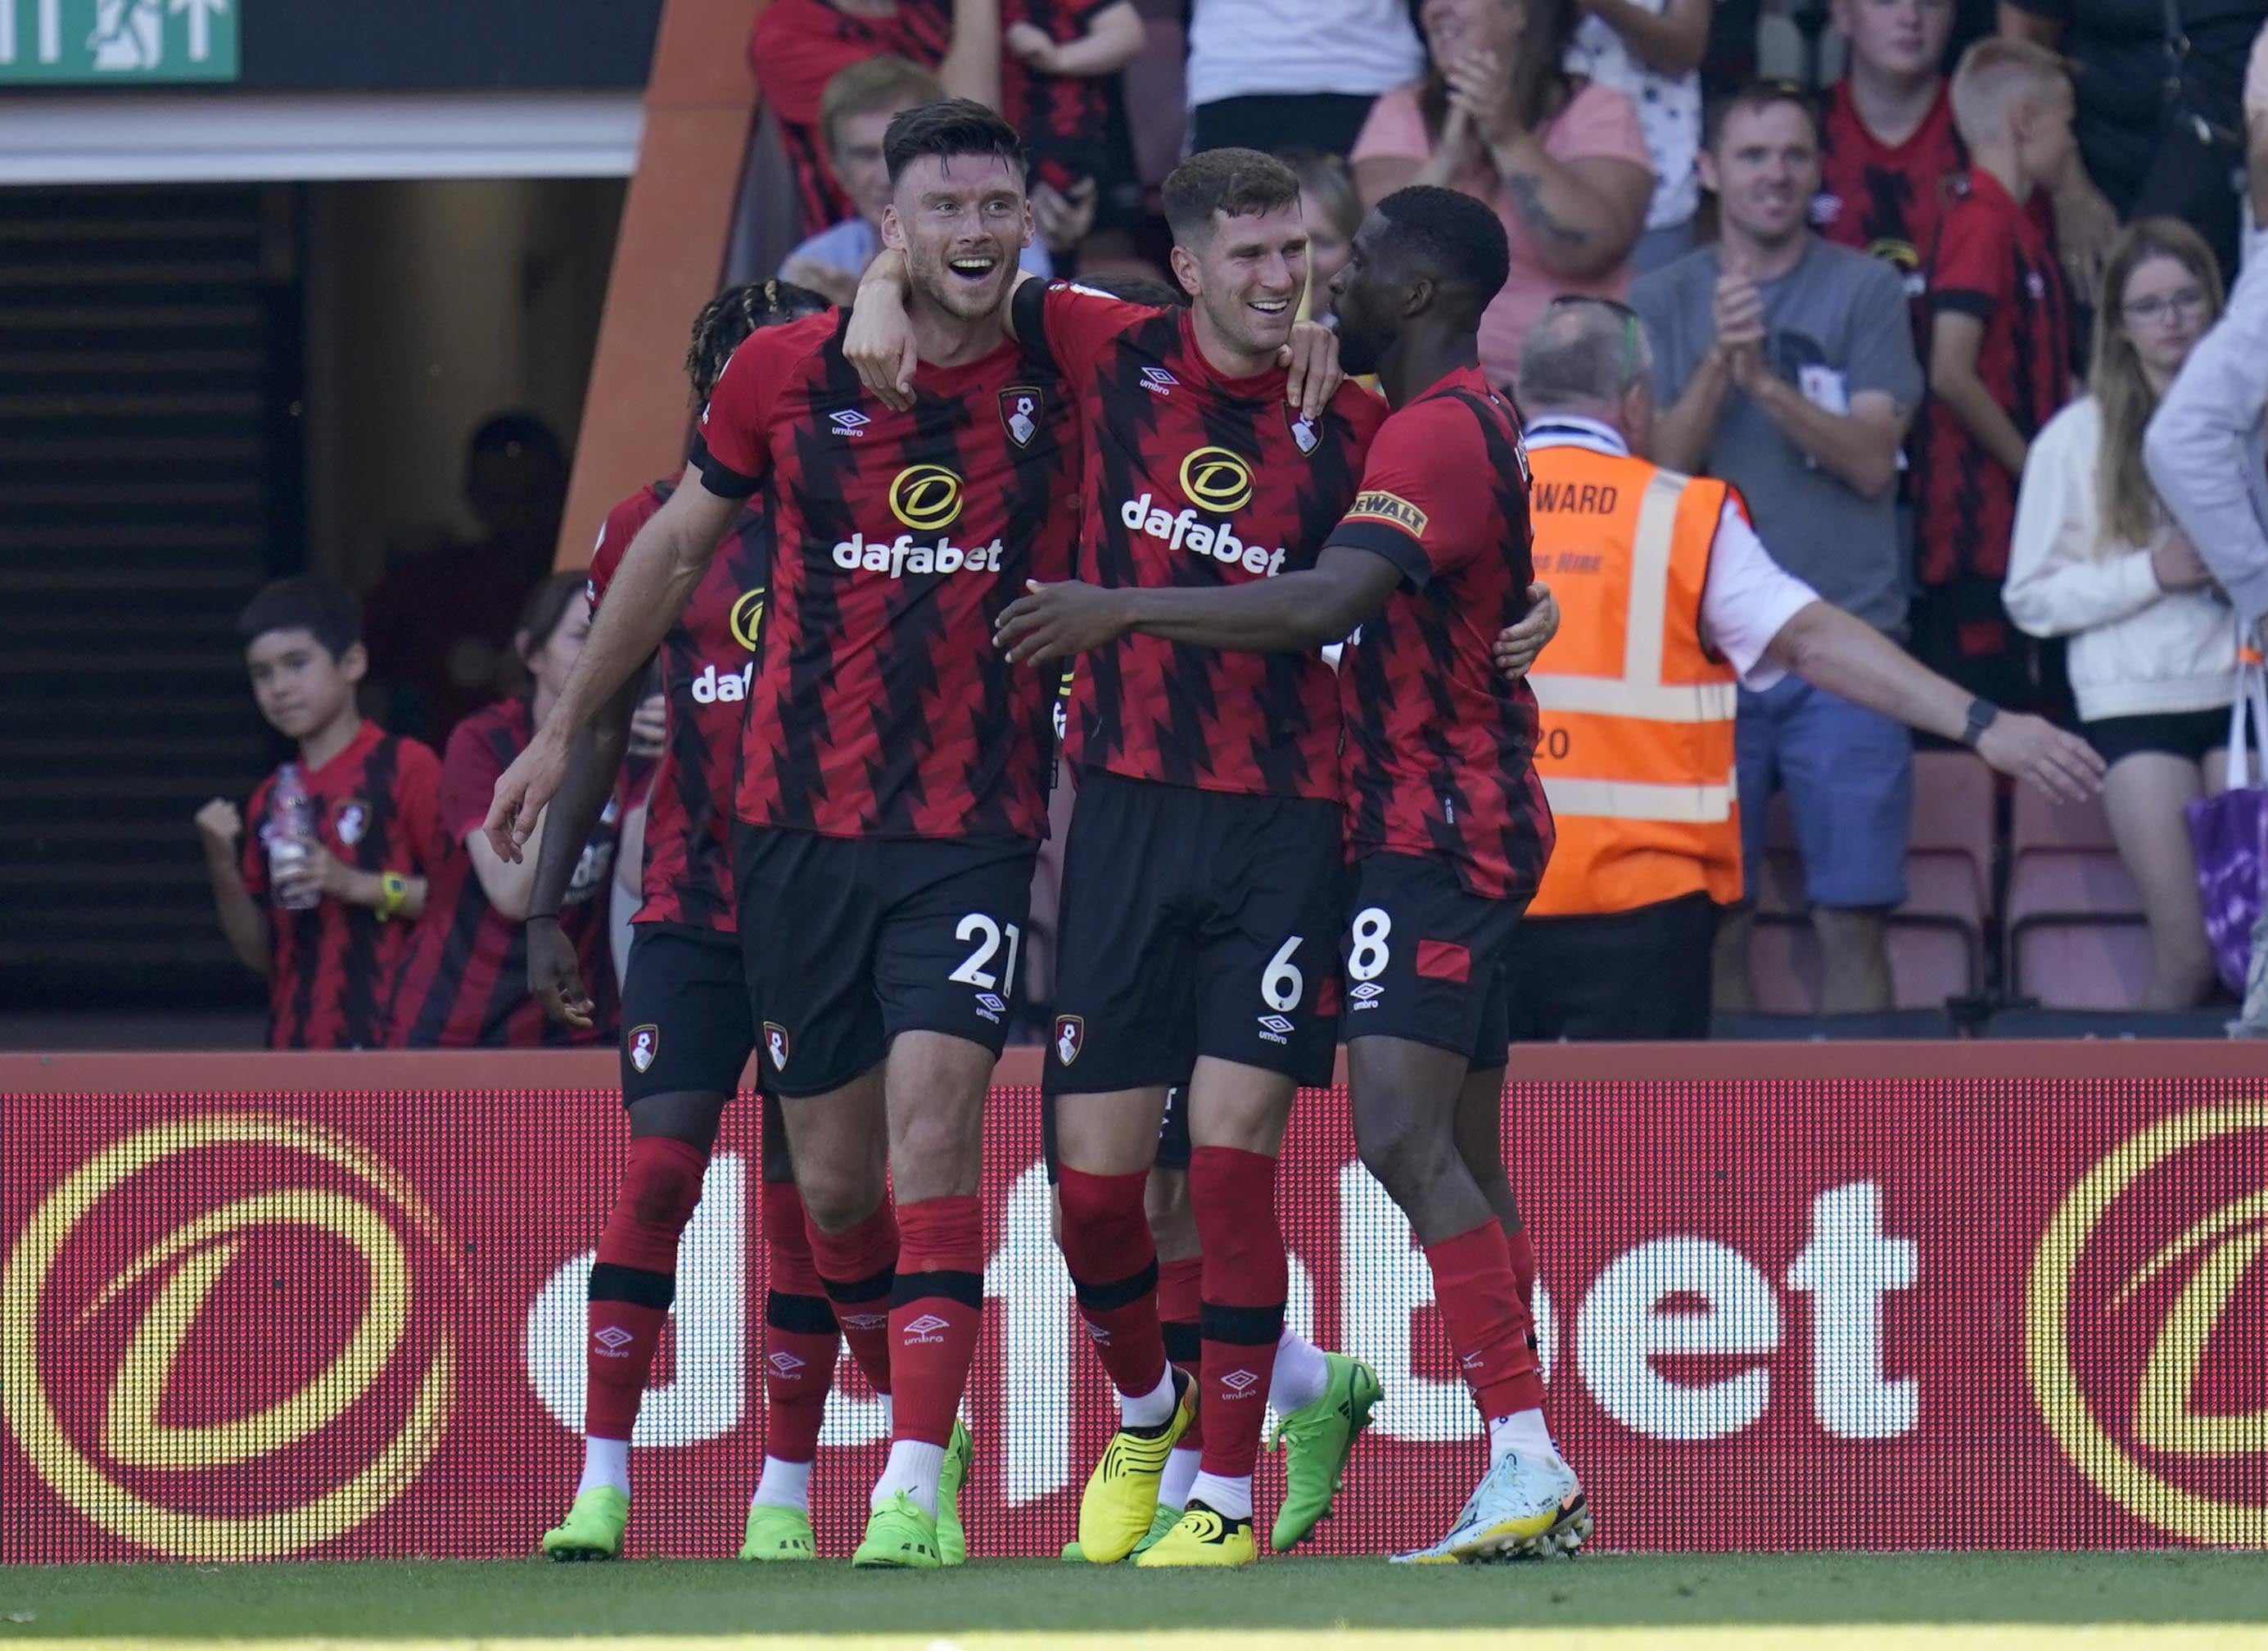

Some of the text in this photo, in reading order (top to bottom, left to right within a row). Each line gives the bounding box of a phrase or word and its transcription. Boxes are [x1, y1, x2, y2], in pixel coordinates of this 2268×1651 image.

[1140, 379, 1170, 396] umbro
[831, 426, 864, 437] umbro
[1534, 482, 1618, 514] WARD
[1121, 493, 1286, 577] dafabet
[832, 532, 1003, 579] dafabet
[948, 912, 1019, 999] 21
[1348, 907, 1392, 981] 8
[1262, 935, 1304, 1012] 6
[1353, 999, 1379, 1011] umbro
[1258, 1030, 1287, 1046] umbro
